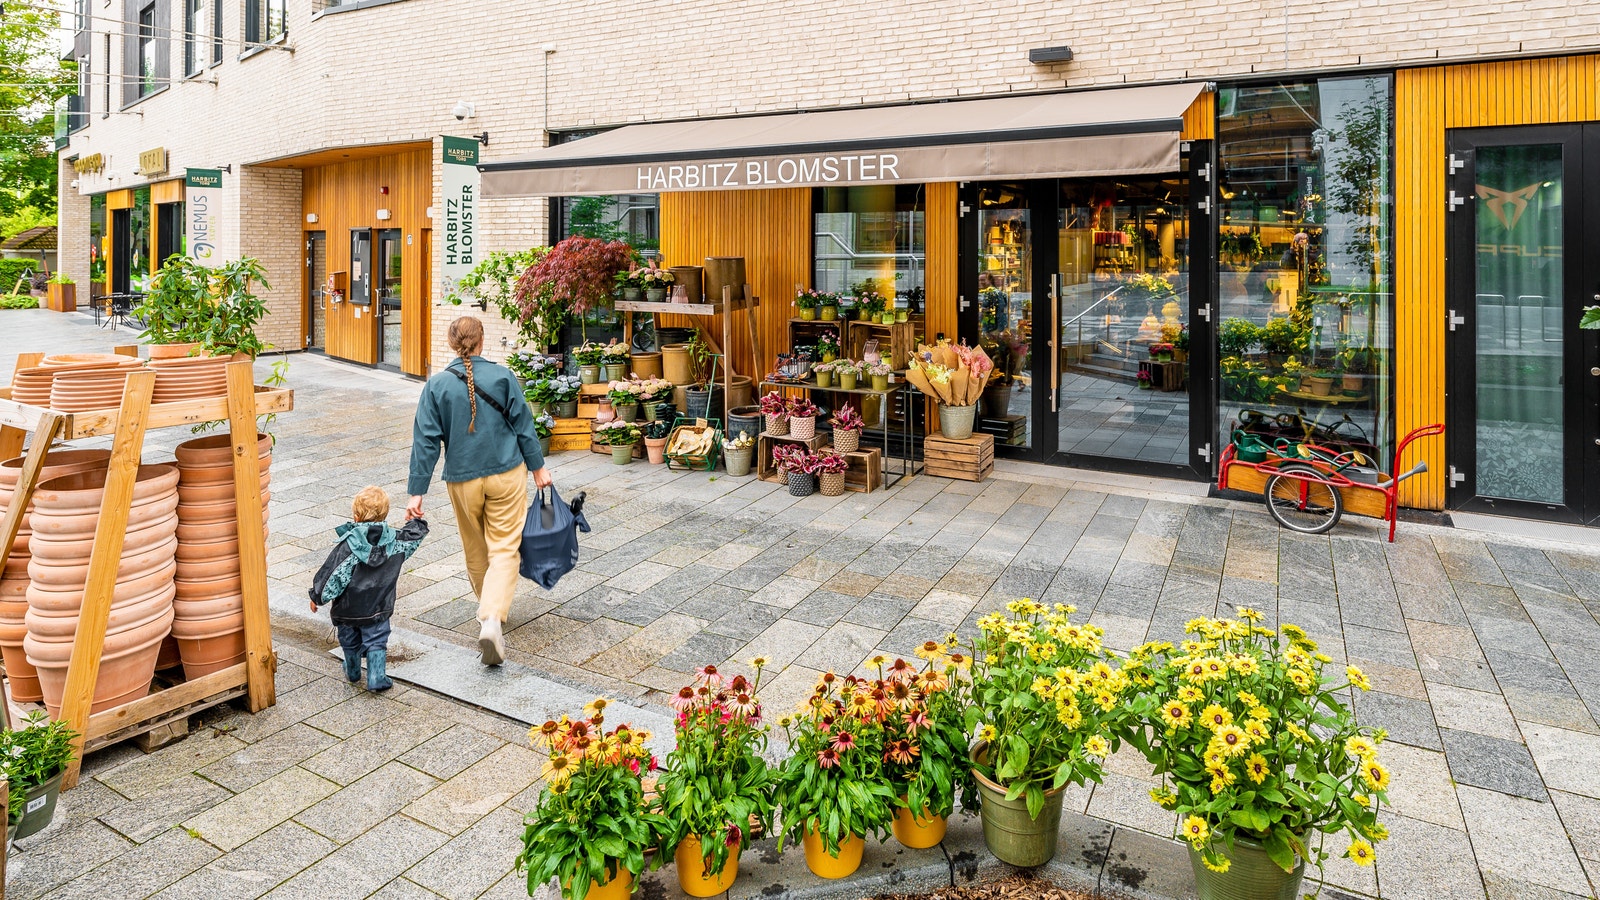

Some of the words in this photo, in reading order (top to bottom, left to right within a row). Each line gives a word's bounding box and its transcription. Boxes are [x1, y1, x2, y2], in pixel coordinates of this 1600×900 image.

[447, 148, 474, 157] HARBITZ
[637, 162, 739, 189] HARBITZ
[746, 154, 901, 185] BLOMSTER
[193, 195, 208, 241] NEMUS
[446, 198, 458, 265] HARBITZ
[461, 184, 473, 264] BLOMSTER
